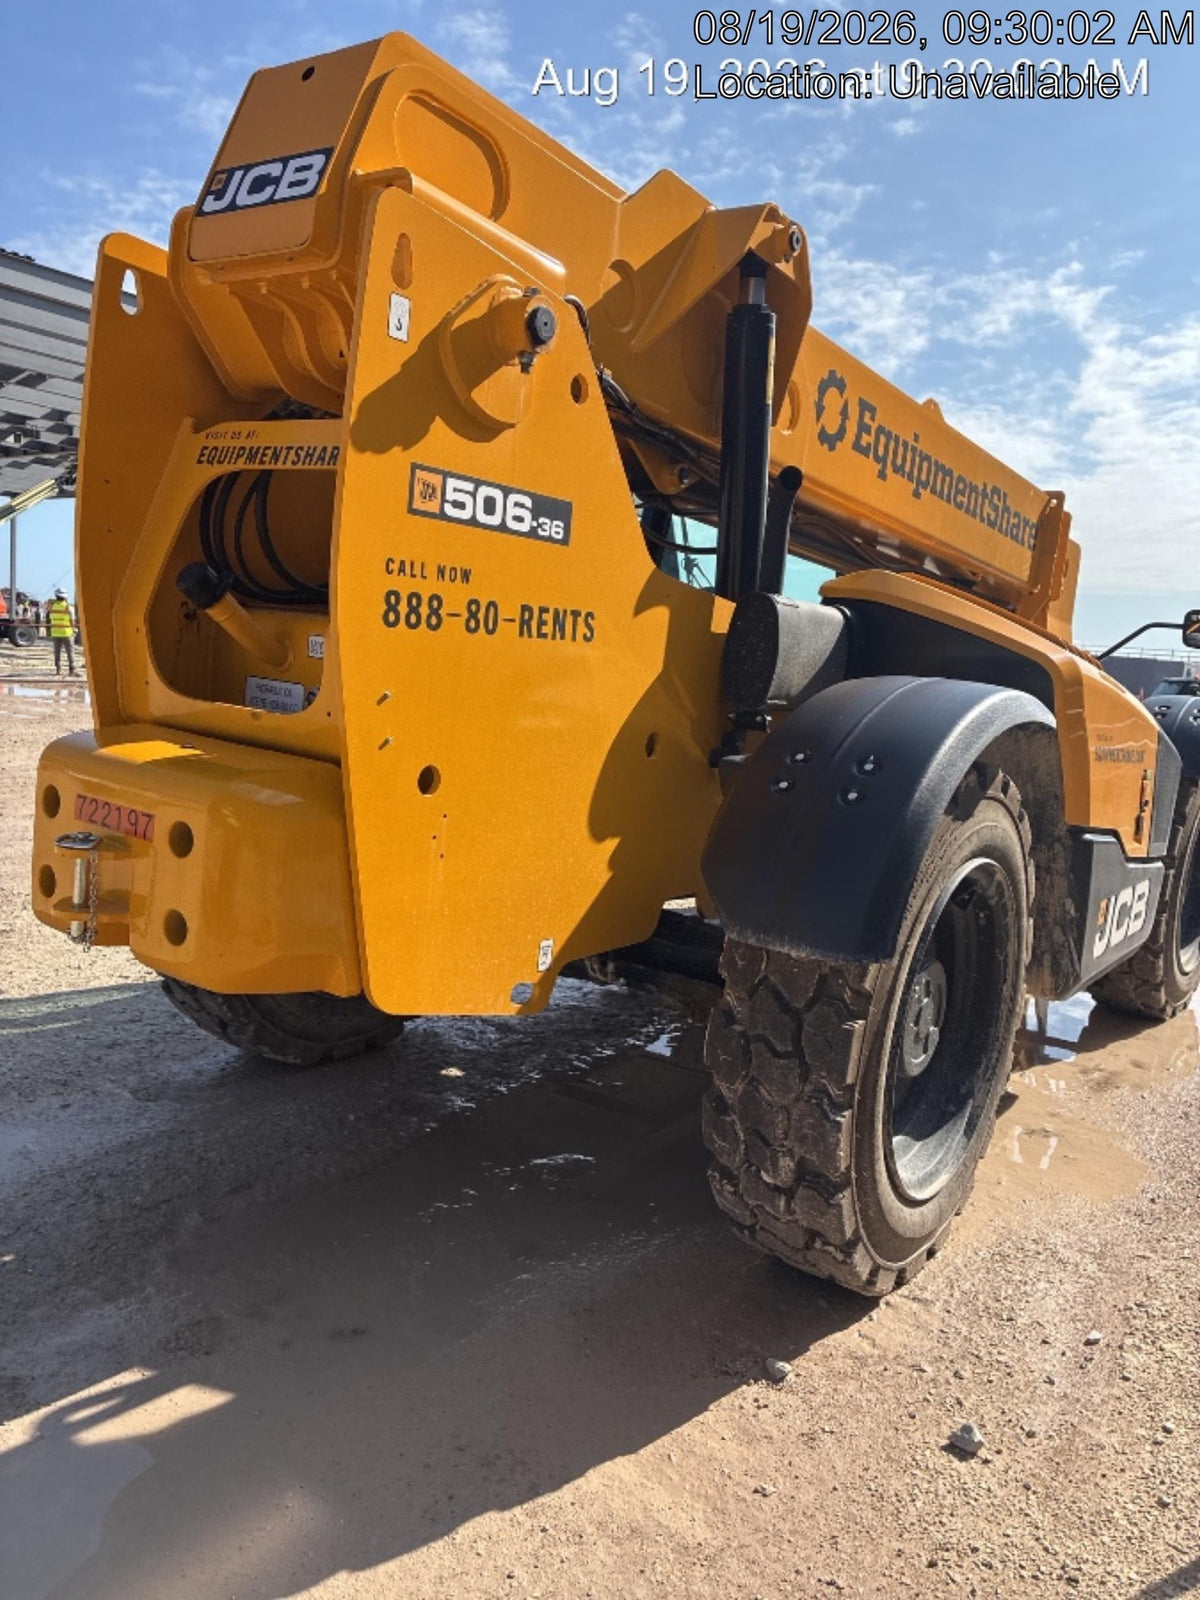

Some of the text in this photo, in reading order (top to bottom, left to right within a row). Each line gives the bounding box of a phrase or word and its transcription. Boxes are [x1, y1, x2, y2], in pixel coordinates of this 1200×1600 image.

[202, 153, 327, 213] JCB
[851, 396, 1038, 552] EquipmentShare
[385, 557, 472, 585] CALL NOW
[382, 589, 596, 643] 888-80-RENTS
[76, 794, 154, 840] 722197
[1093, 879, 1150, 960] JCB
